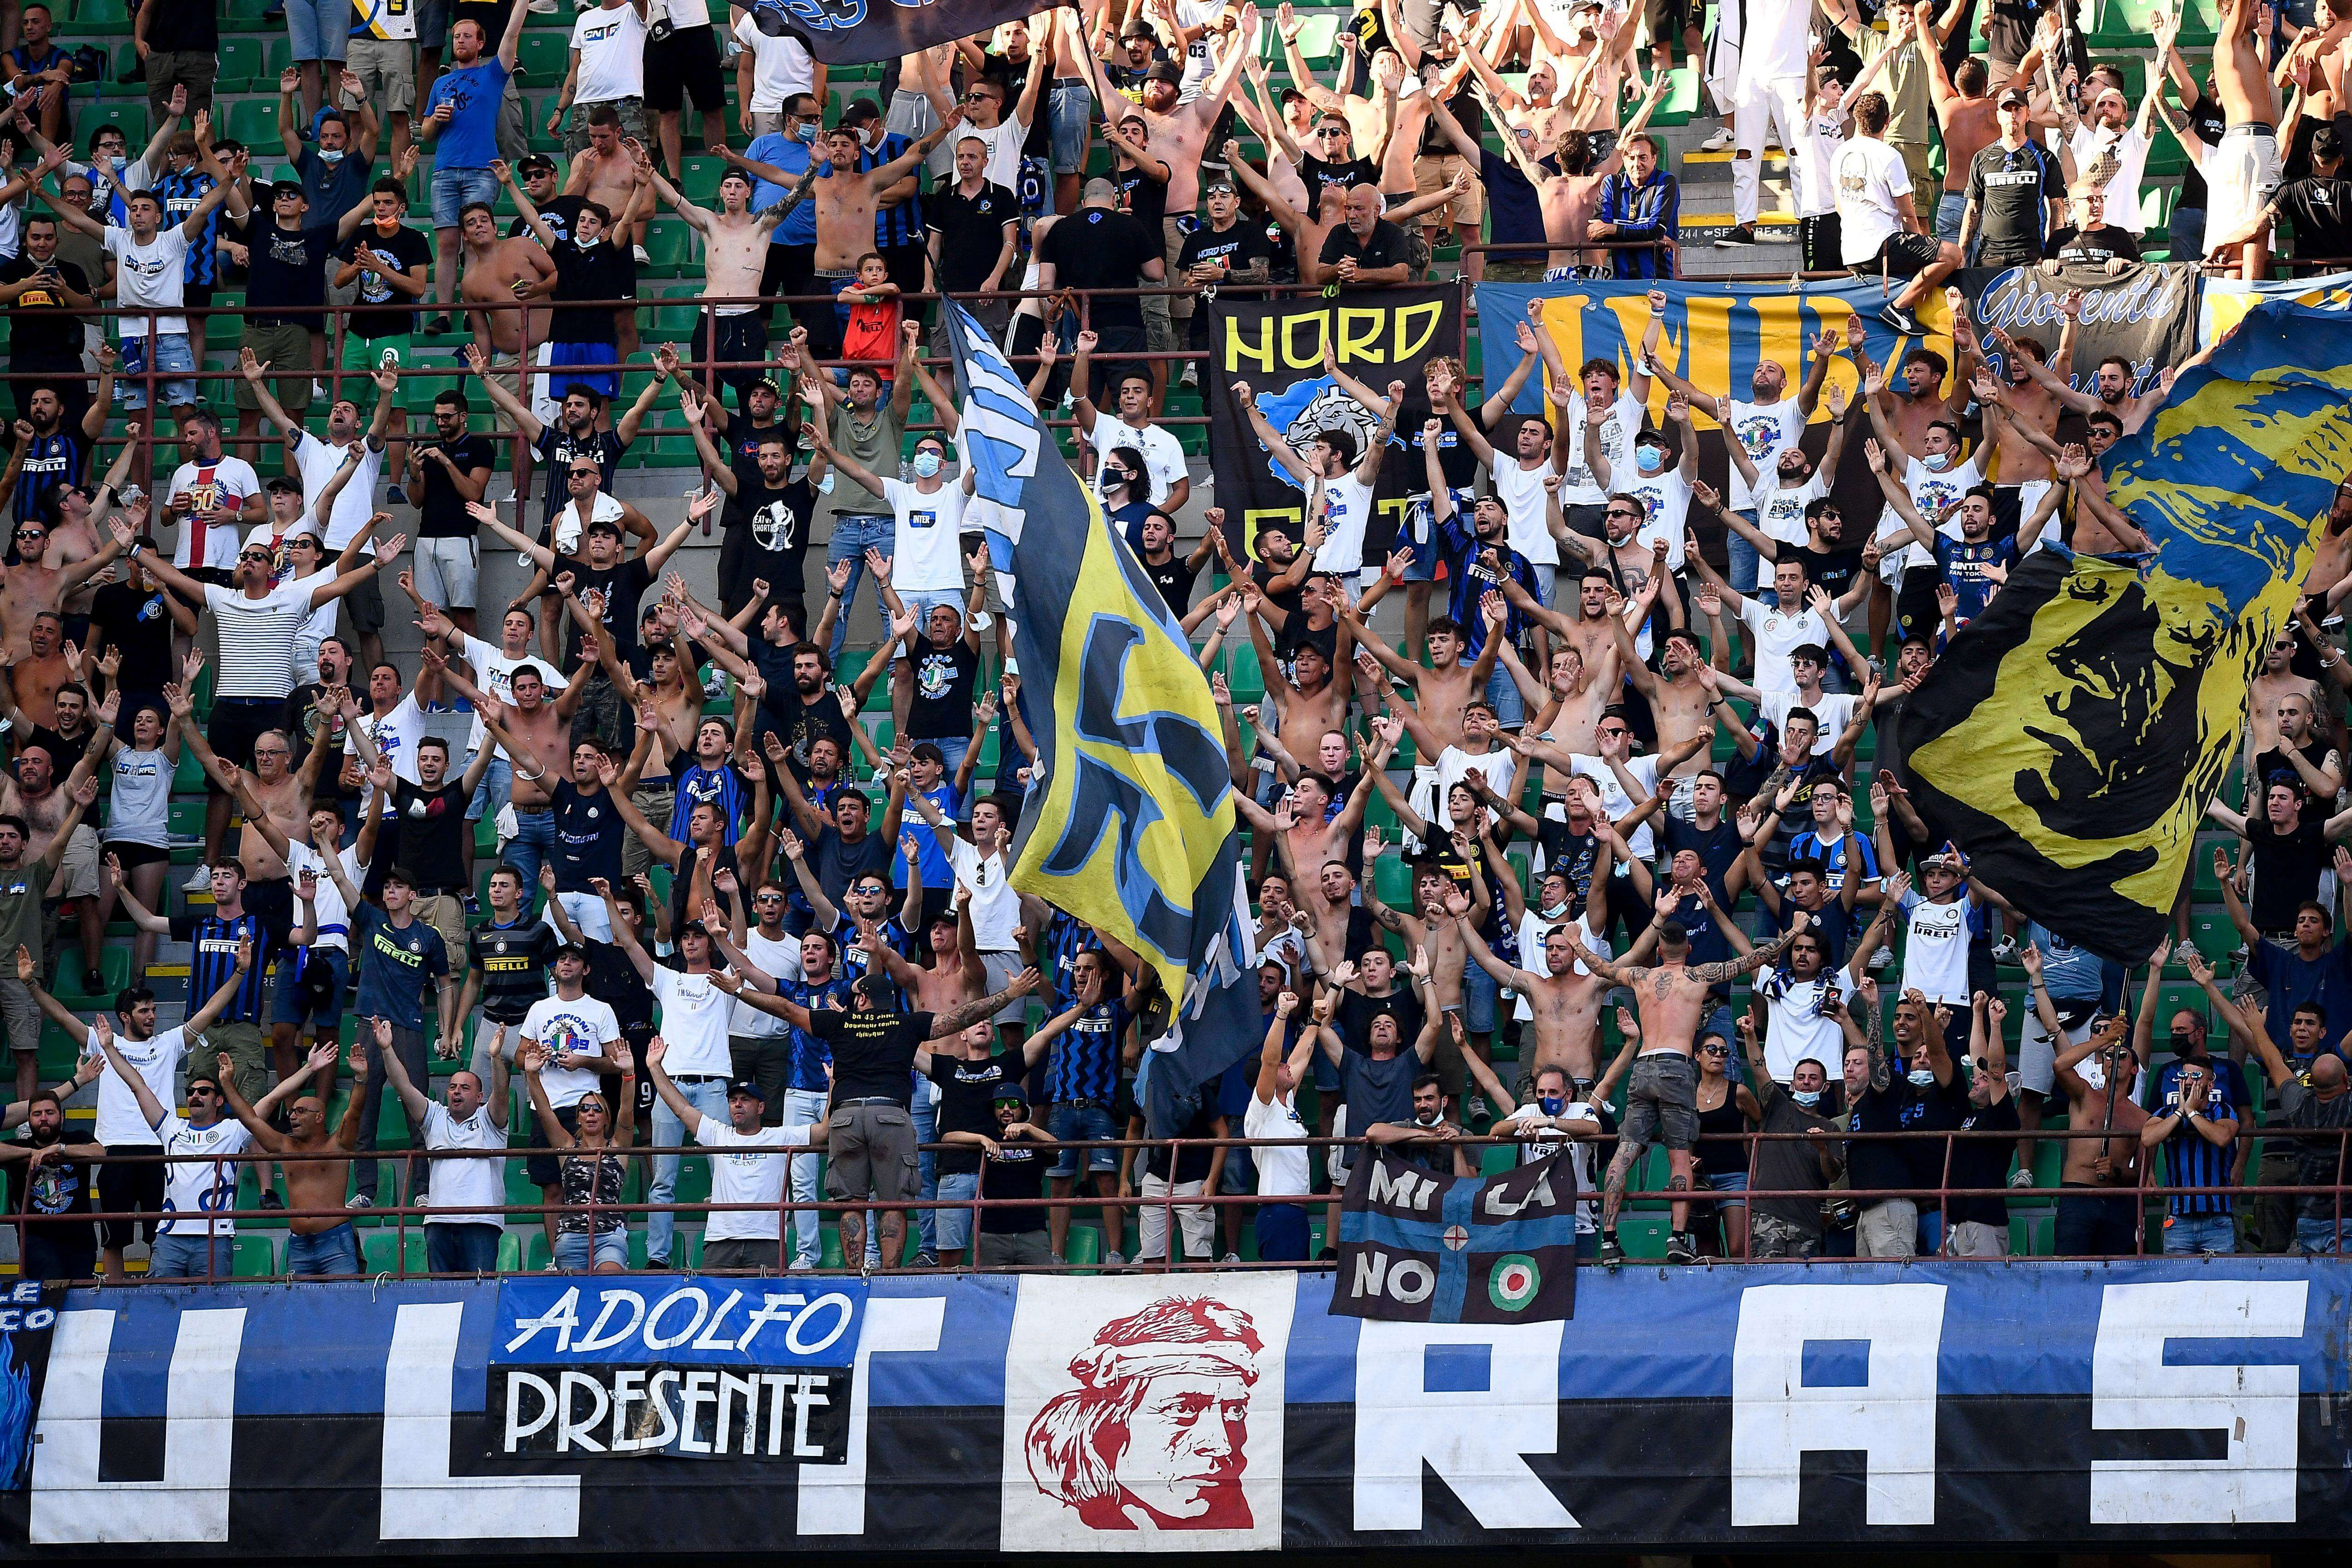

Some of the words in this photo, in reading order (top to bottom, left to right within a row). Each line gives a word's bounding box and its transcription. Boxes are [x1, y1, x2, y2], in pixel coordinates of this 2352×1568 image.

[1188, 45, 1206, 58] 03
[1198, 248, 1219, 259] NORD
[1221, 242, 1238, 252] EST
[2059, 248, 2114, 259] IMBATISCI
[23, 293, 53, 304] PIREL
[1977, 264, 2174, 350] Gioentù
[1225, 300, 1443, 372] NORD
[192, 490, 216, 511] 50
[754, 515, 765, 524] EAT
[754, 524, 774, 533] SHORTS
[913, 515, 930, 524] INTER
[1949, 561, 1984, 571] $INTE
[139, 766, 156, 775] RAS
[200, 940, 240, 954] PIREL
[374, 934, 423, 968] PIRELLI
[542, 1014, 589, 1034] CAMPIONI
[641, 1082, 651, 1101] 9
[1369, 1160, 1439, 1211] MI
[1485, 1167, 1556, 1216] LA
[1351, 1251, 1435, 1304] NO
[505, 1285, 853, 1355] ADOLFO
[504, 1370, 830, 1457] PRESENTE
